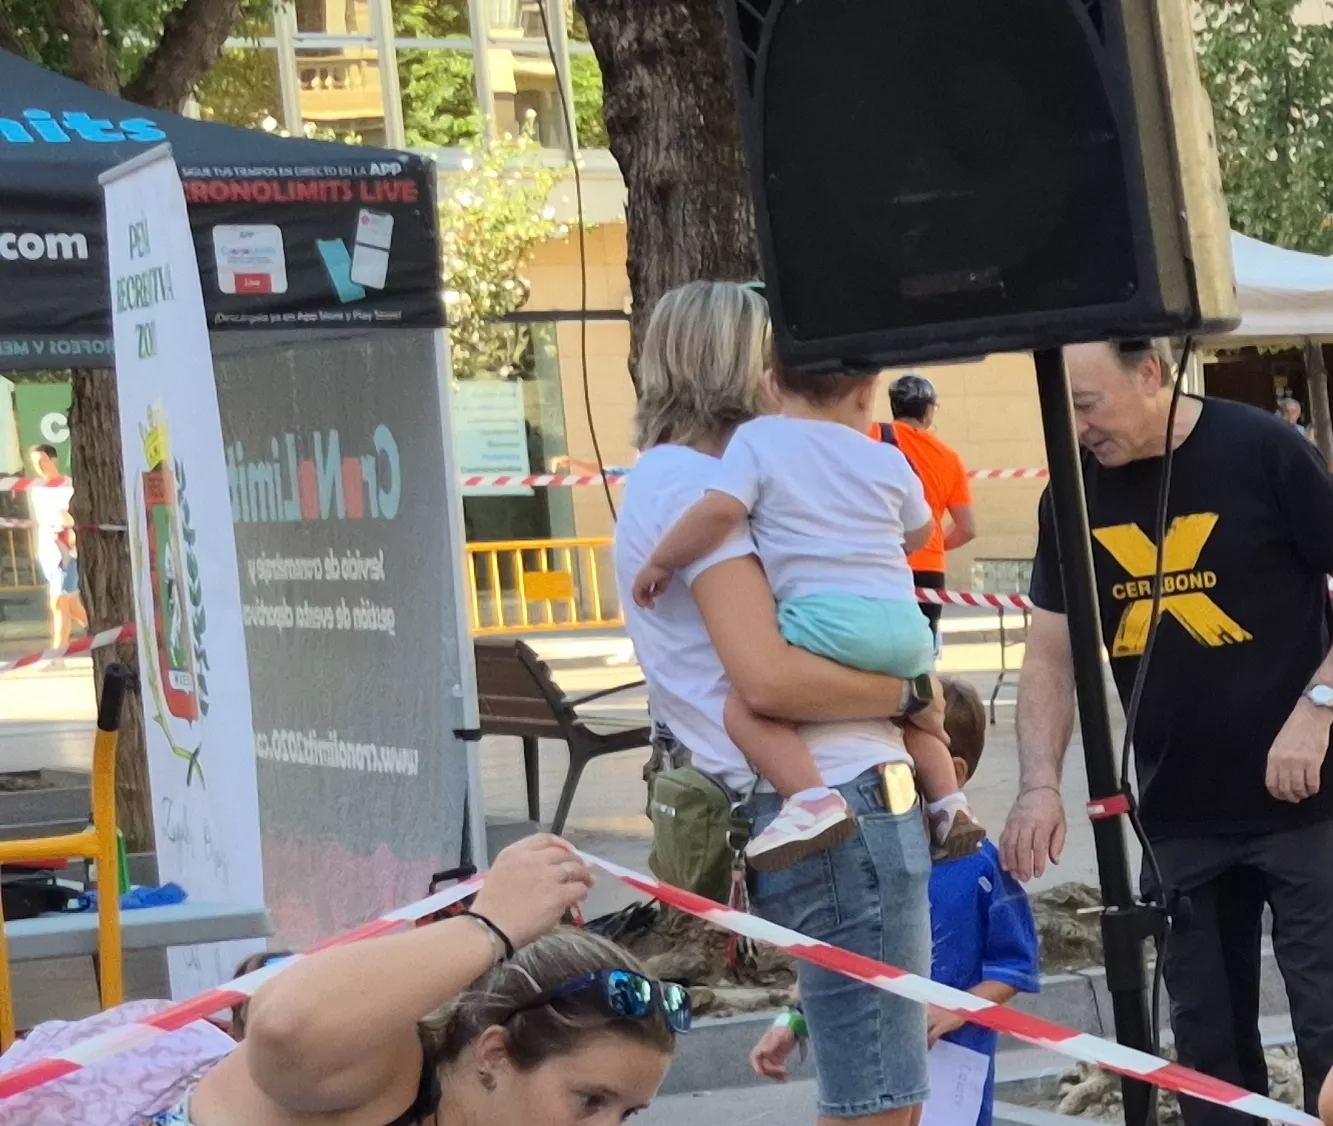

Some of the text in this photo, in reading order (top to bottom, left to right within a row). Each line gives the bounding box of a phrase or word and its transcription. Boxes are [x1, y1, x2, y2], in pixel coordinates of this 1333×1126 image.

[369, 162, 402, 176] APP
[359, 180, 418, 202] LIVE
[1112, 571, 1217, 599] CERBOND
